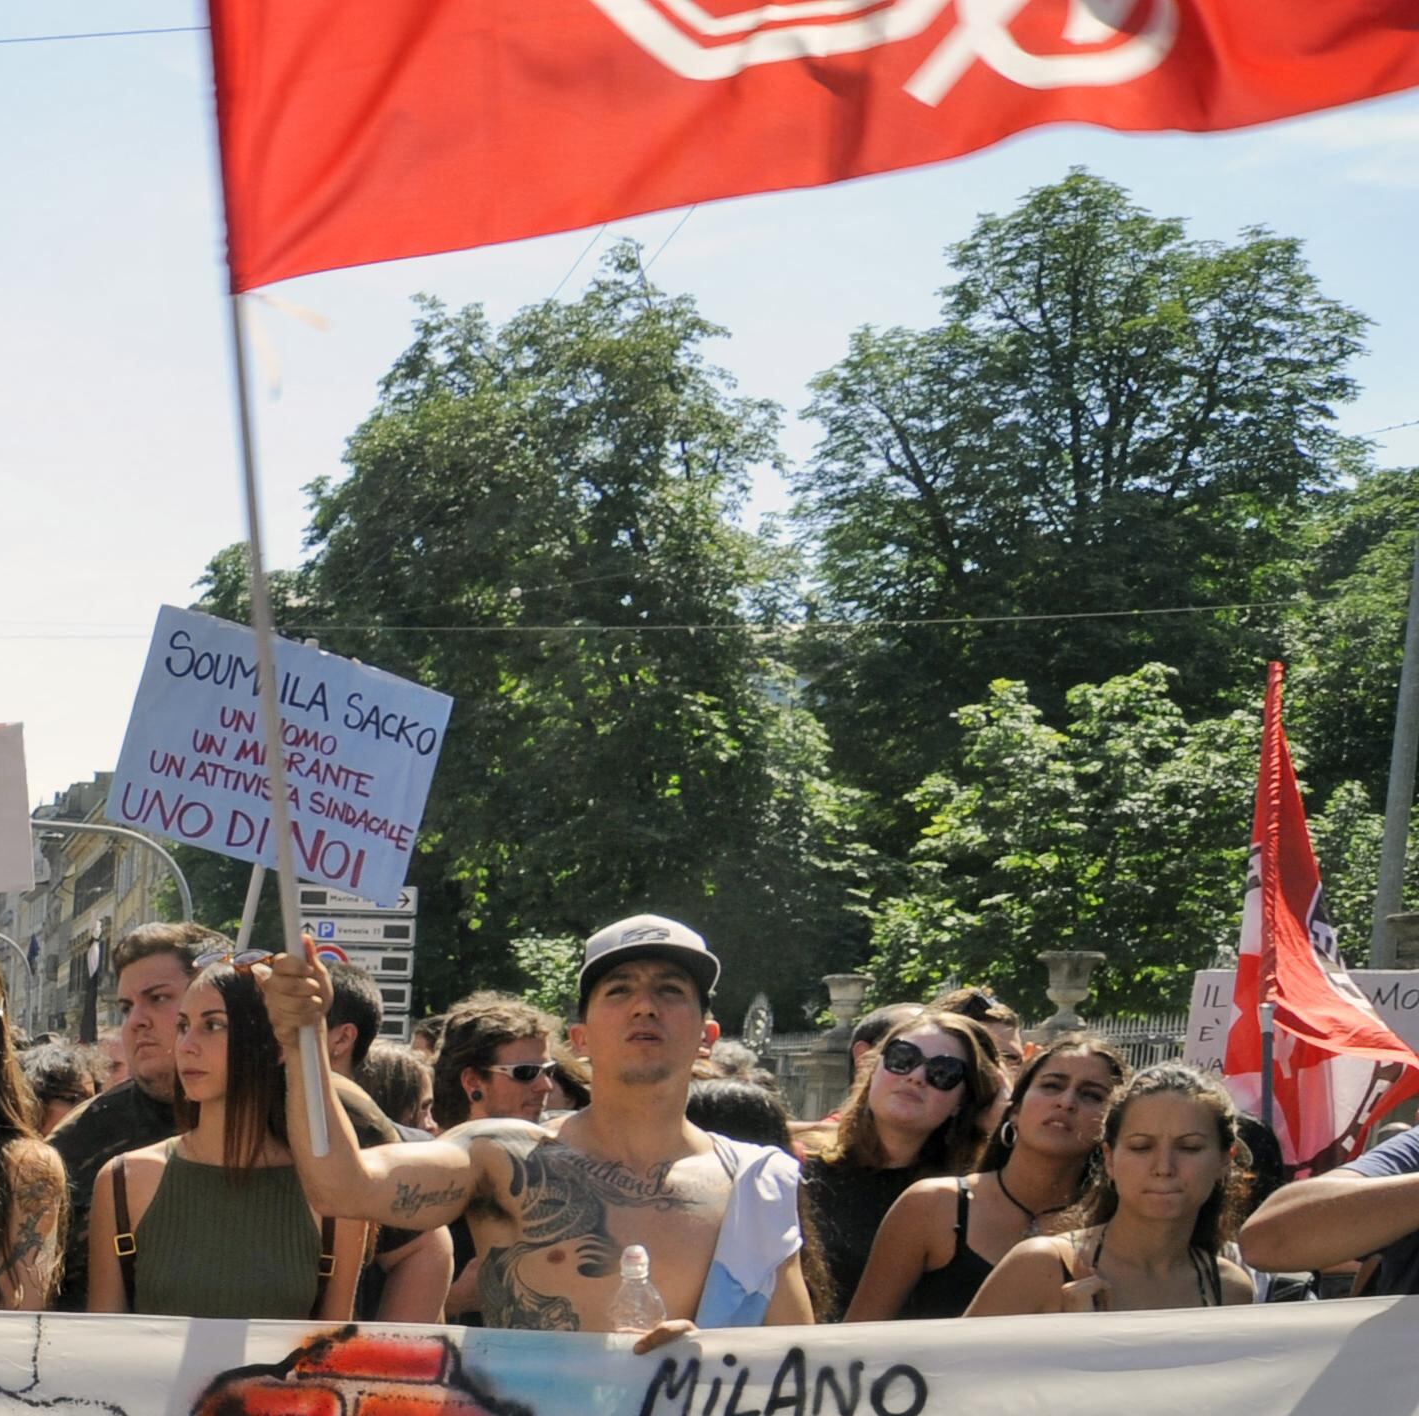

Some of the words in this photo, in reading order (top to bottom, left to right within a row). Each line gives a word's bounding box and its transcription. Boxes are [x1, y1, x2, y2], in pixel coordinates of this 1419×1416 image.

[164, 629, 330, 722] SOUMILA
[343, 692, 437, 756] SACKO
[219, 705, 257, 734] UN
[192, 728, 227, 758] UN
[149, 749, 187, 779] UN
[308, 791, 414, 852] SINDACALE
[121, 781, 214, 839] UNO
[225, 809, 270, 856] DI
[290, 820, 366, 889] NOI
[1202, 983, 1227, 1008] IL
